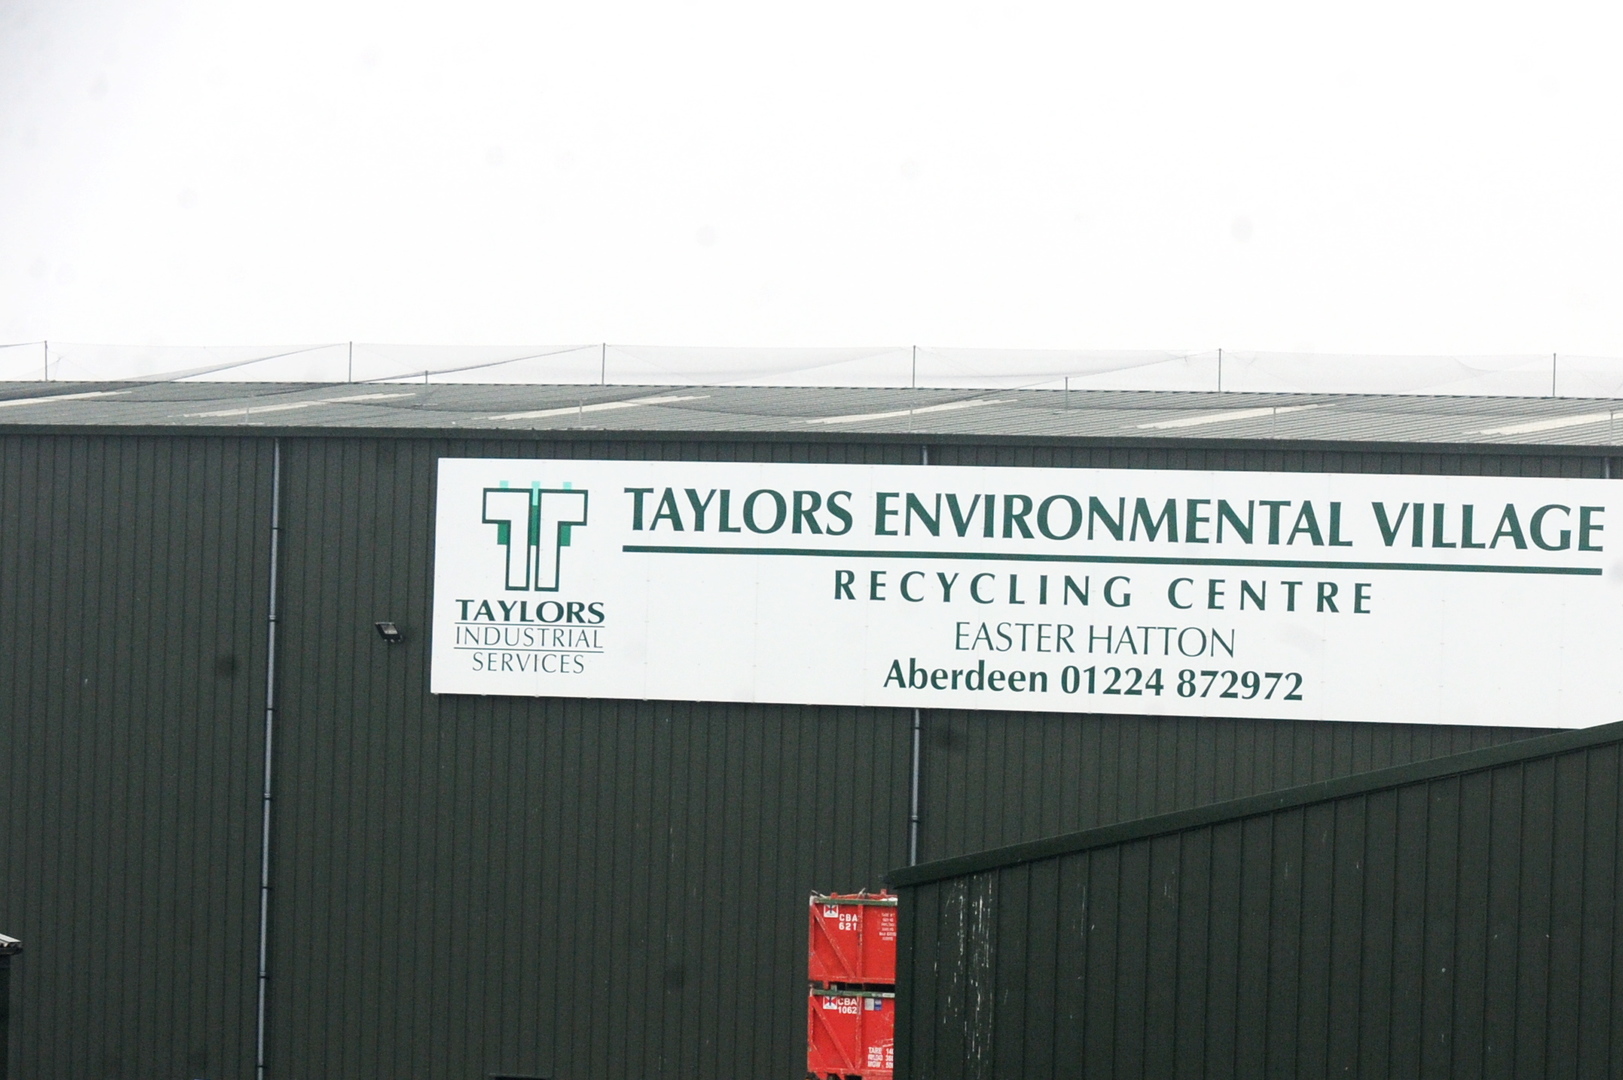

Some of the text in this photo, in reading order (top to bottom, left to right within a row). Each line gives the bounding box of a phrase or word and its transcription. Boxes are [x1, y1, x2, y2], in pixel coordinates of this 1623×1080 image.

[624, 487, 1605, 552] TAYLORS ENVIRONMENTAL VILLAGE
[834, 569, 1373, 615] RECYCLING CENTRE
[455, 599, 605, 624] TAYLORS
[456, 626, 603, 648] INDUSTRIAL
[954, 621, 1236, 658] EASTER HATTON
[472, 652, 585, 674] SERVICES
[883, 657, 1304, 701] Aberdeen 01224 872972
[838, 922, 857, 931] 621
[839, 913, 858, 922] CBA
[837, 998, 858, 1006] CBA
[838, 1006, 857, 1015] 1062
